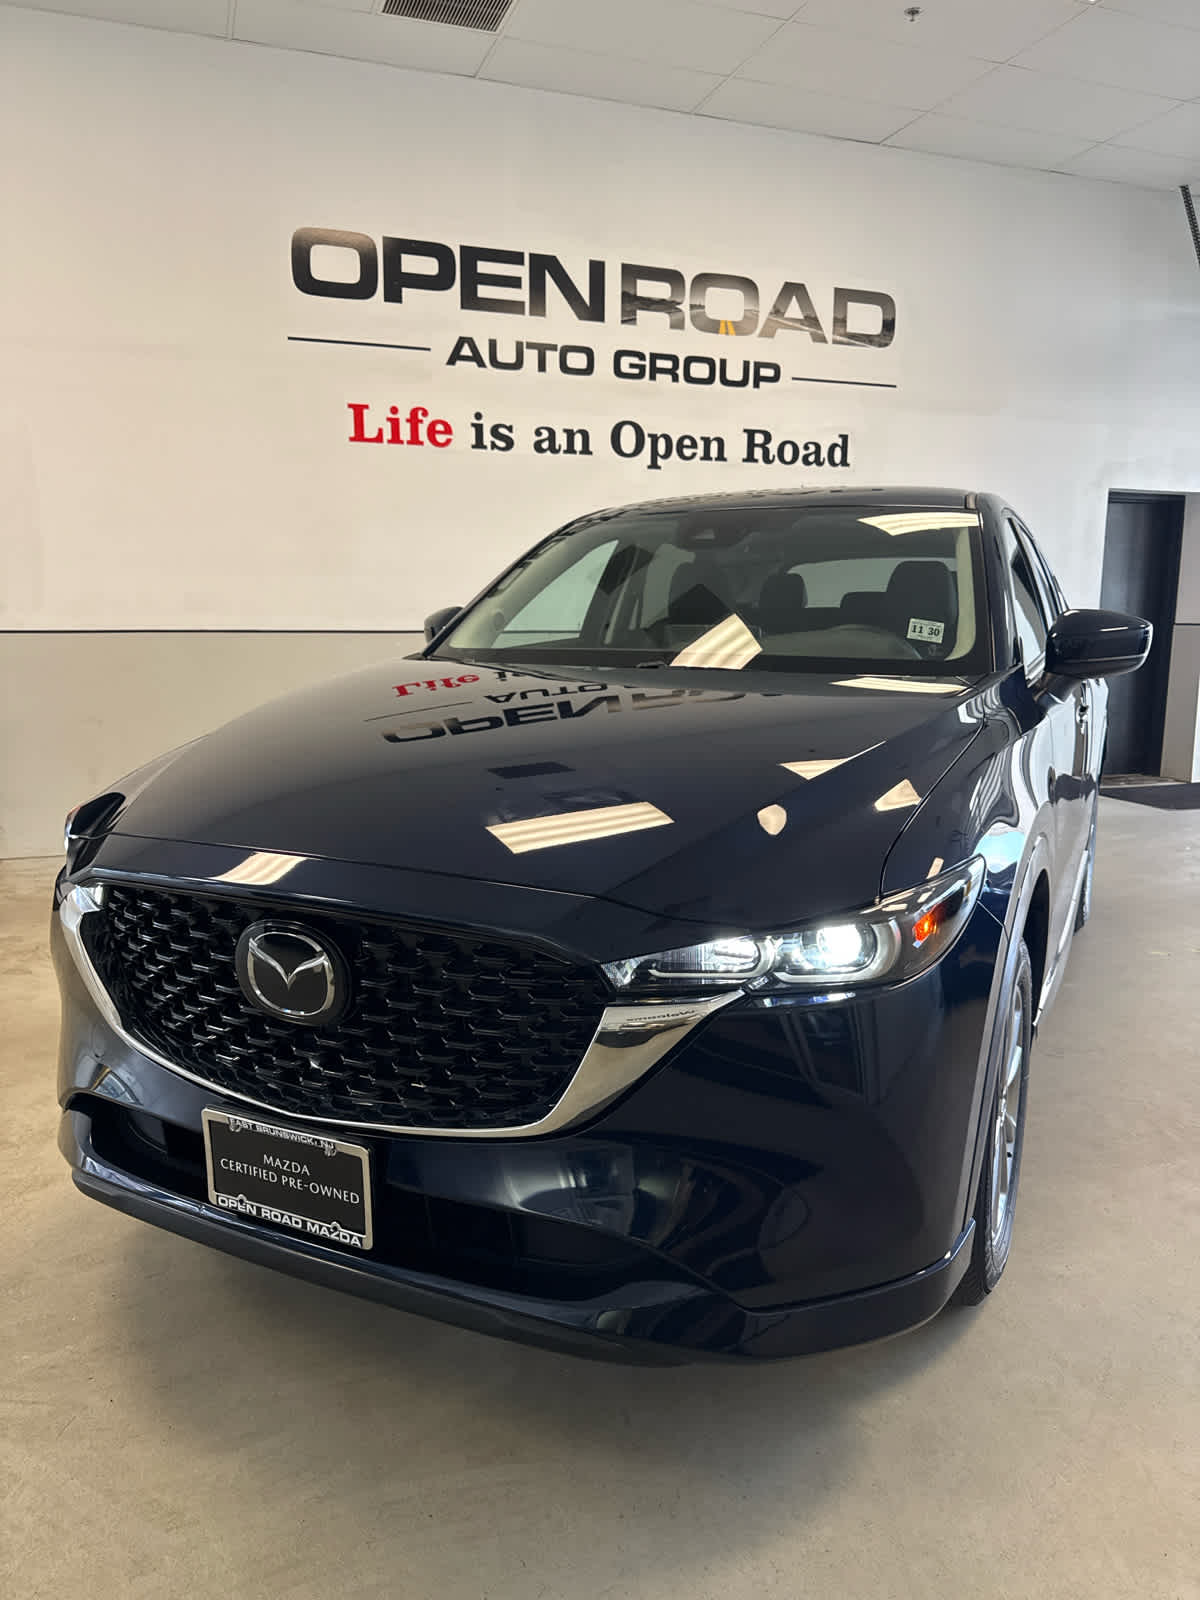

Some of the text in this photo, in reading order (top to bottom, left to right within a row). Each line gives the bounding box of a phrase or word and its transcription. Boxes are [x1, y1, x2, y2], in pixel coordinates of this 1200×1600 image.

[291, 227, 897, 349] OPEN ROAD
[446, 336, 782, 389] AUTO GROUP
[347, 402, 851, 470] Life is an Open Road
[911, 624, 924, 634] 11
[927, 626, 940, 637] 30
[220, 1158, 360, 1205] CERTIFIED PRE-OWNED
[263, 1153, 311, 1177] MAZDA
[217, 1195, 362, 1248] OPEN ROAD MAZDA
